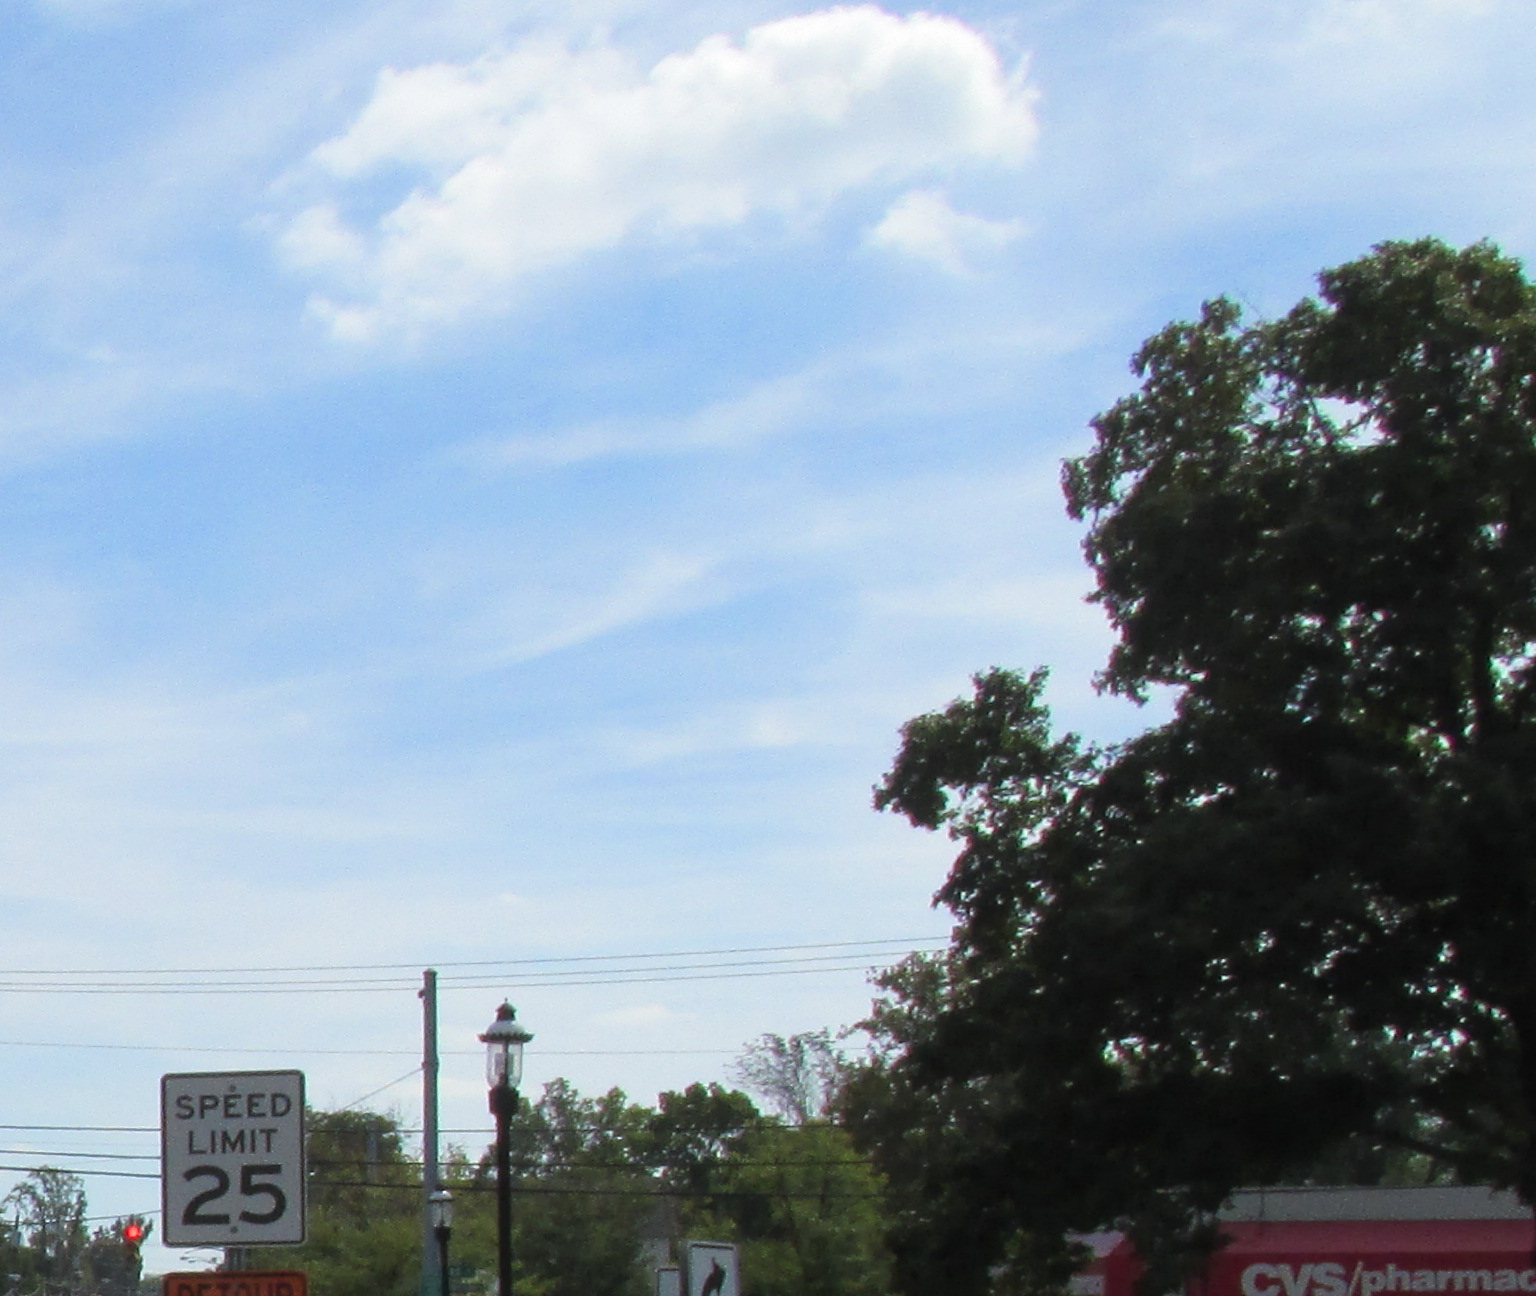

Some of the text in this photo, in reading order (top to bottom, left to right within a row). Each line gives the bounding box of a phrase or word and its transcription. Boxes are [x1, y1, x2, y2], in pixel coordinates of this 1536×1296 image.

[175, 1093, 292, 1120] SPEED
[188, 1128, 278, 1154] LIMIT
[182, 1164, 286, 1225] 25
